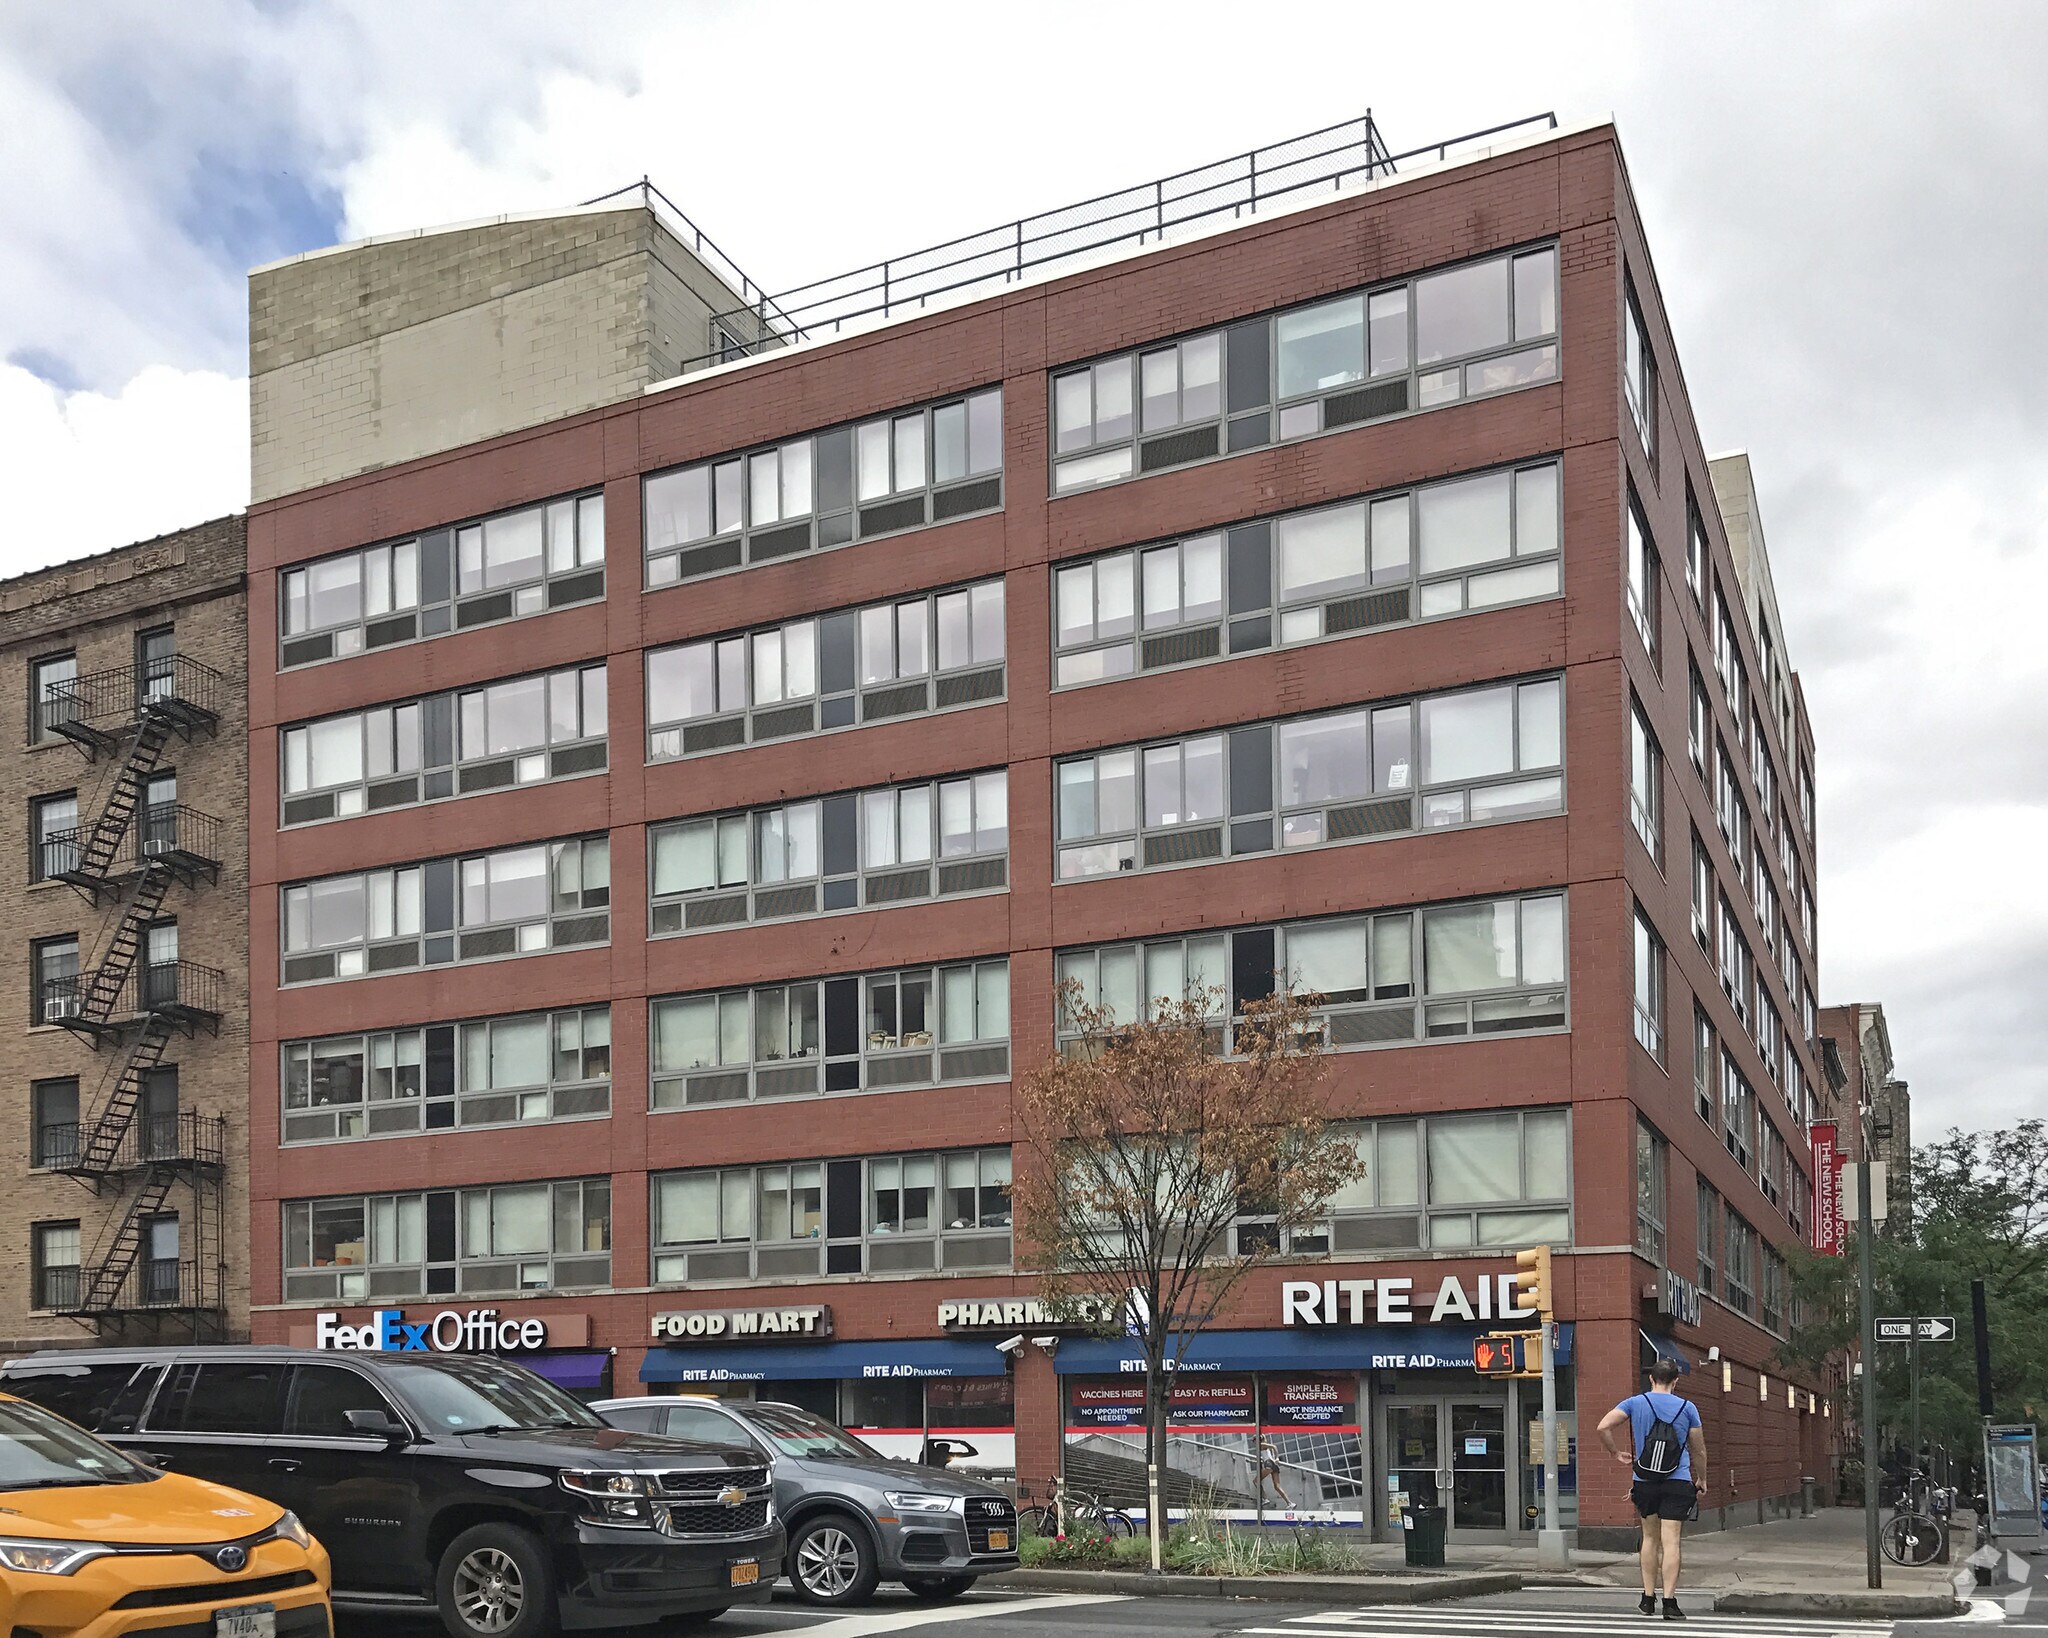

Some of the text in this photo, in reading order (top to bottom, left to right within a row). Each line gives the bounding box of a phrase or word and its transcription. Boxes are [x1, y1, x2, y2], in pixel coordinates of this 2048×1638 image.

[1821, 1140, 1833, 1248] THE NEW SCHOOL
[1835, 1220, 1845, 1258] SCHOO
[1282, 1277, 1413, 1325] RITE
[938, 1299, 1115, 1326] PHARMCY
[651, 1310, 819, 1337] FOOD MART
[1883, 1325, 1905, 1334] ONE
[316, 1309, 545, 1352] FedEx Office
[1372, 1354, 1476, 1368] RITE AID PHARMA
[1501, 1344, 1511, 1366] 5
[863, 1365, 952, 1377] RITE AID PHARMACY
[1120, 1360, 1148, 1372] RITE
[1178, 1362, 1221, 1371] PHARMACY
[683, 1369, 765, 1381] RITE AID PHARMACY
[1080, 1389, 1144, 1399] VACCINES HERE
[1174, 1388, 1247, 1397] EASY Rx REFILLS
[1287, 1384, 1335, 1392] SIMPLE Rx
[1283, 1392, 1338, 1400] TRANSFERS
[1081, 1407, 1143, 1416] NO APPOINTMENT
[1172, 1410, 1187, 1418] ASK
[1204, 1409, 1249, 1417] PHARMACIST
[1279, 1405, 1344, 1414] MOST INSURANCE
[1097, 1414, 1128, 1422] NEEDED
[344, 1517, 401, 1527] SUBURBAN
